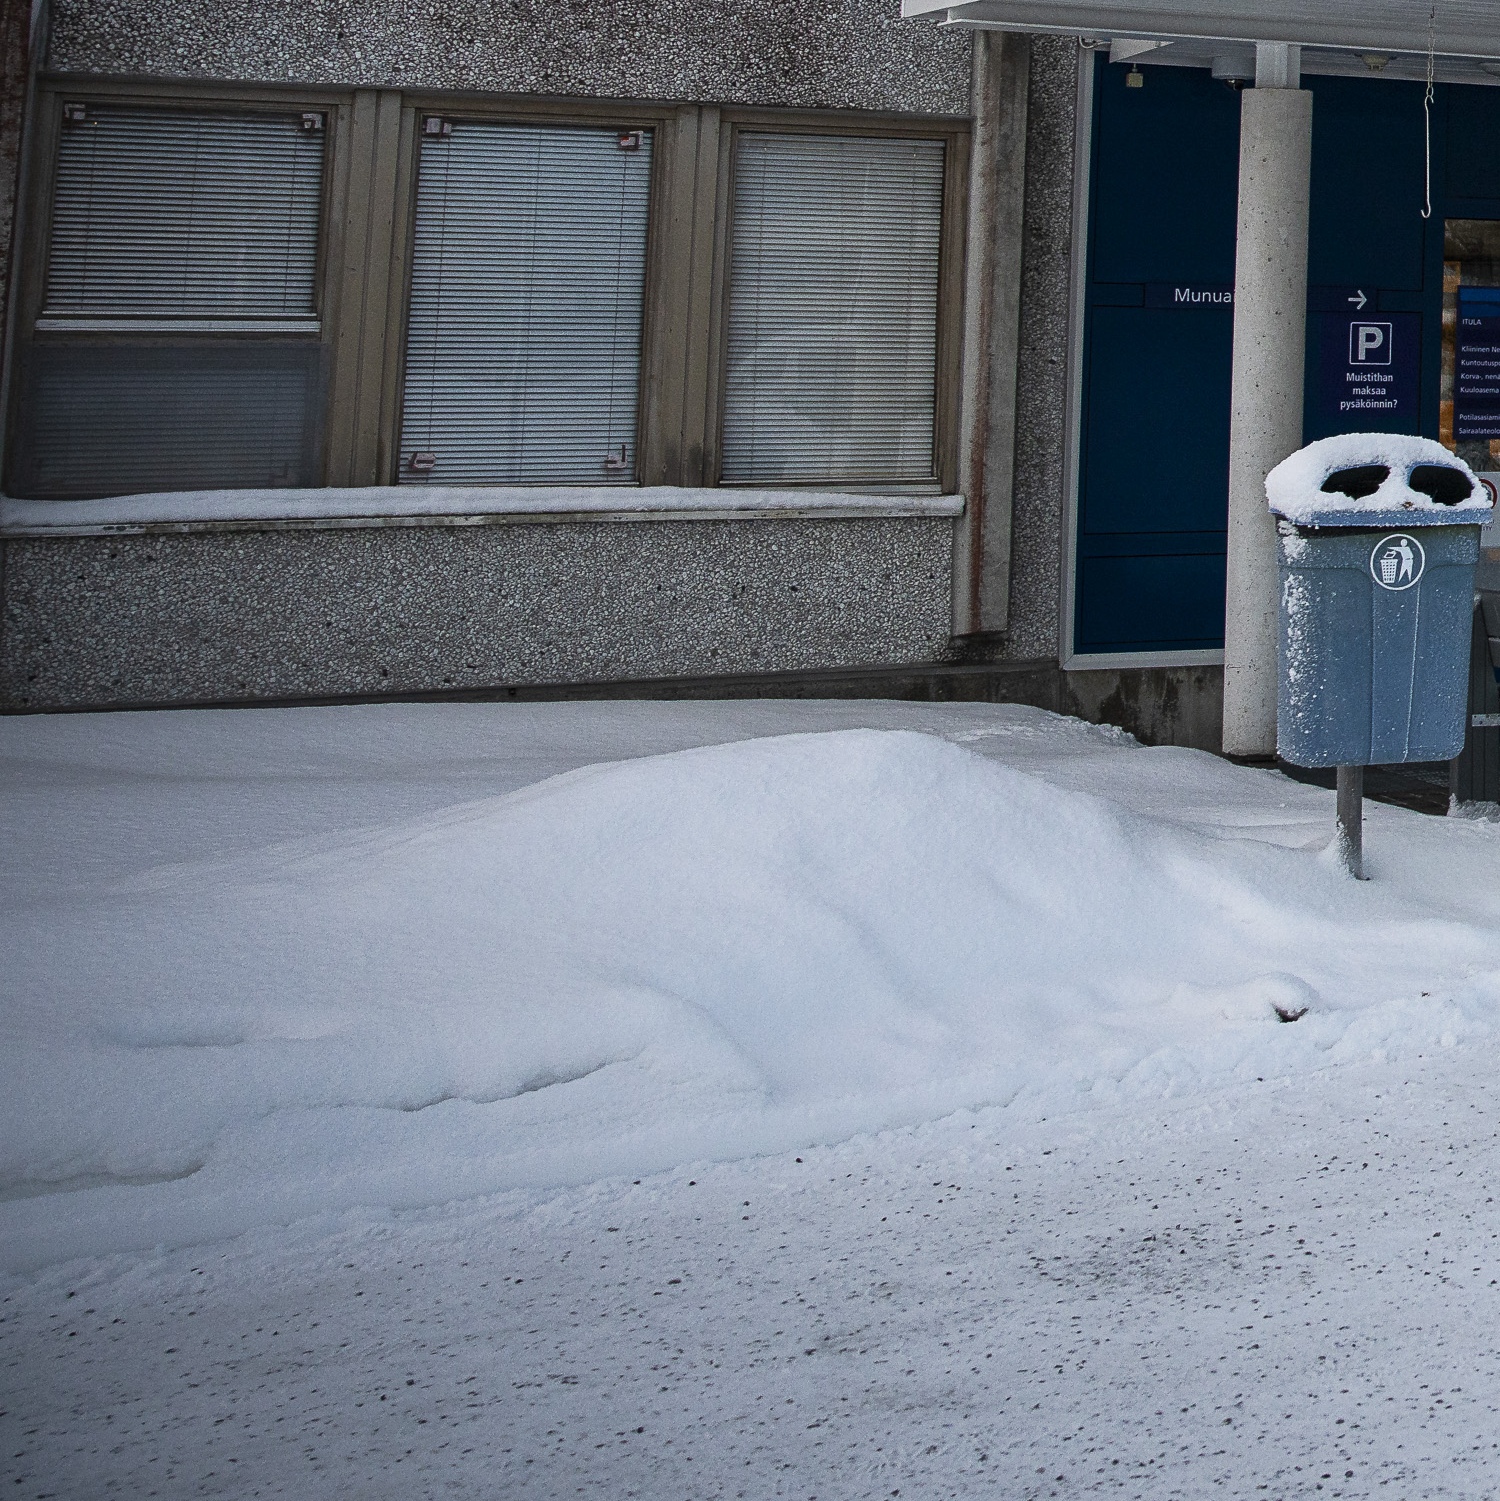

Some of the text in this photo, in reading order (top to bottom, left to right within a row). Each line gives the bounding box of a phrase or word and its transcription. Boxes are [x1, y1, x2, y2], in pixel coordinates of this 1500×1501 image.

[1358, 326, 1384, 360] P
[1461, 345, 1490, 353] Kliininen
[1346, 372, 1394, 382] Muistithan
[1352, 386, 1386, 395] maksaa
[1340, 399, 1398, 410] pysäköinnin?
